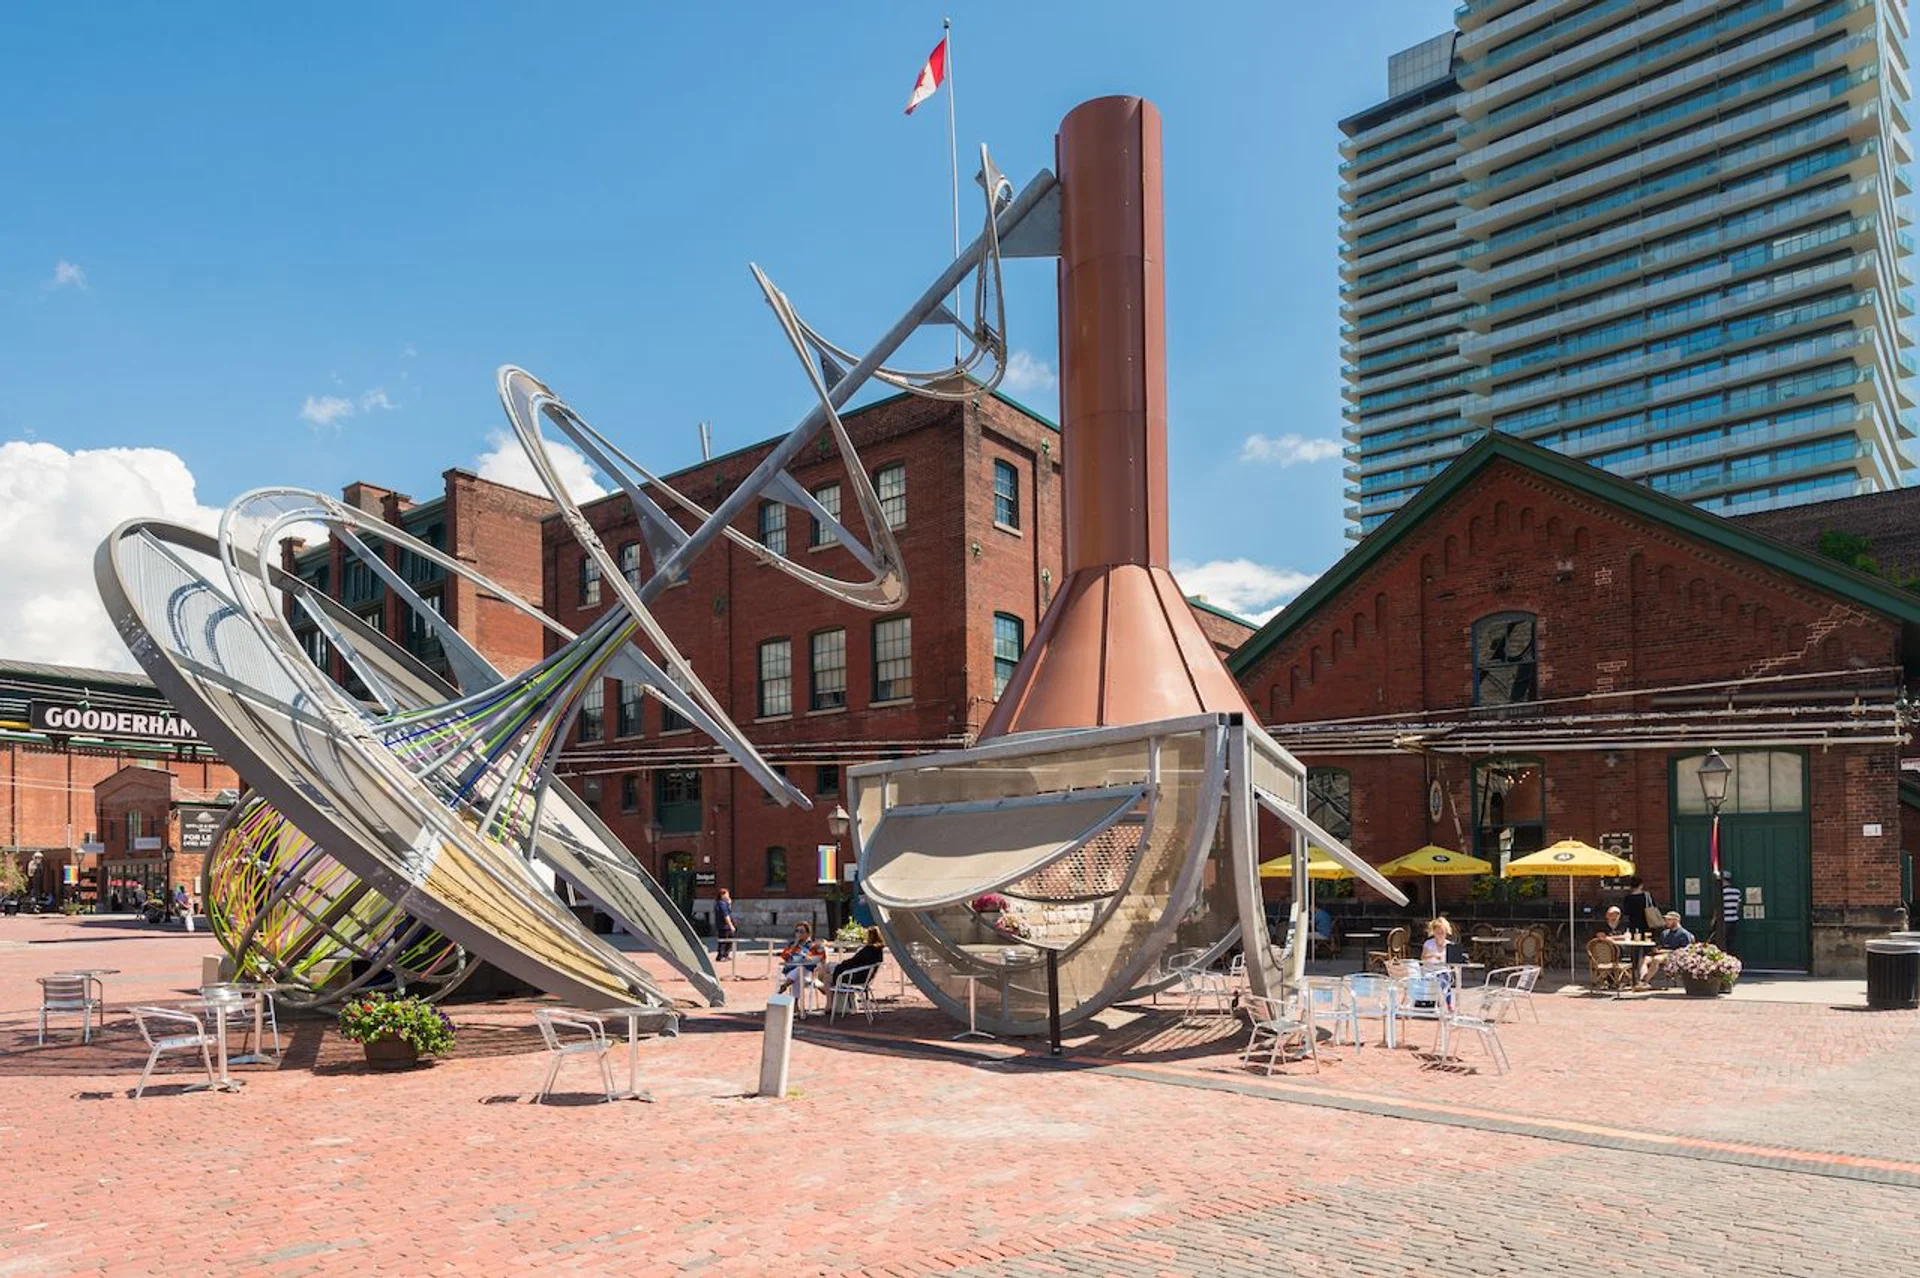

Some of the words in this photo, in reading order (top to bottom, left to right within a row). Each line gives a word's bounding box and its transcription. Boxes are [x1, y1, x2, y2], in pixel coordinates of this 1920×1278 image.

[44, 706, 198, 738] GOODERHAM
[183, 834, 201, 842] FOR
[202, 834, 212, 842] LE
